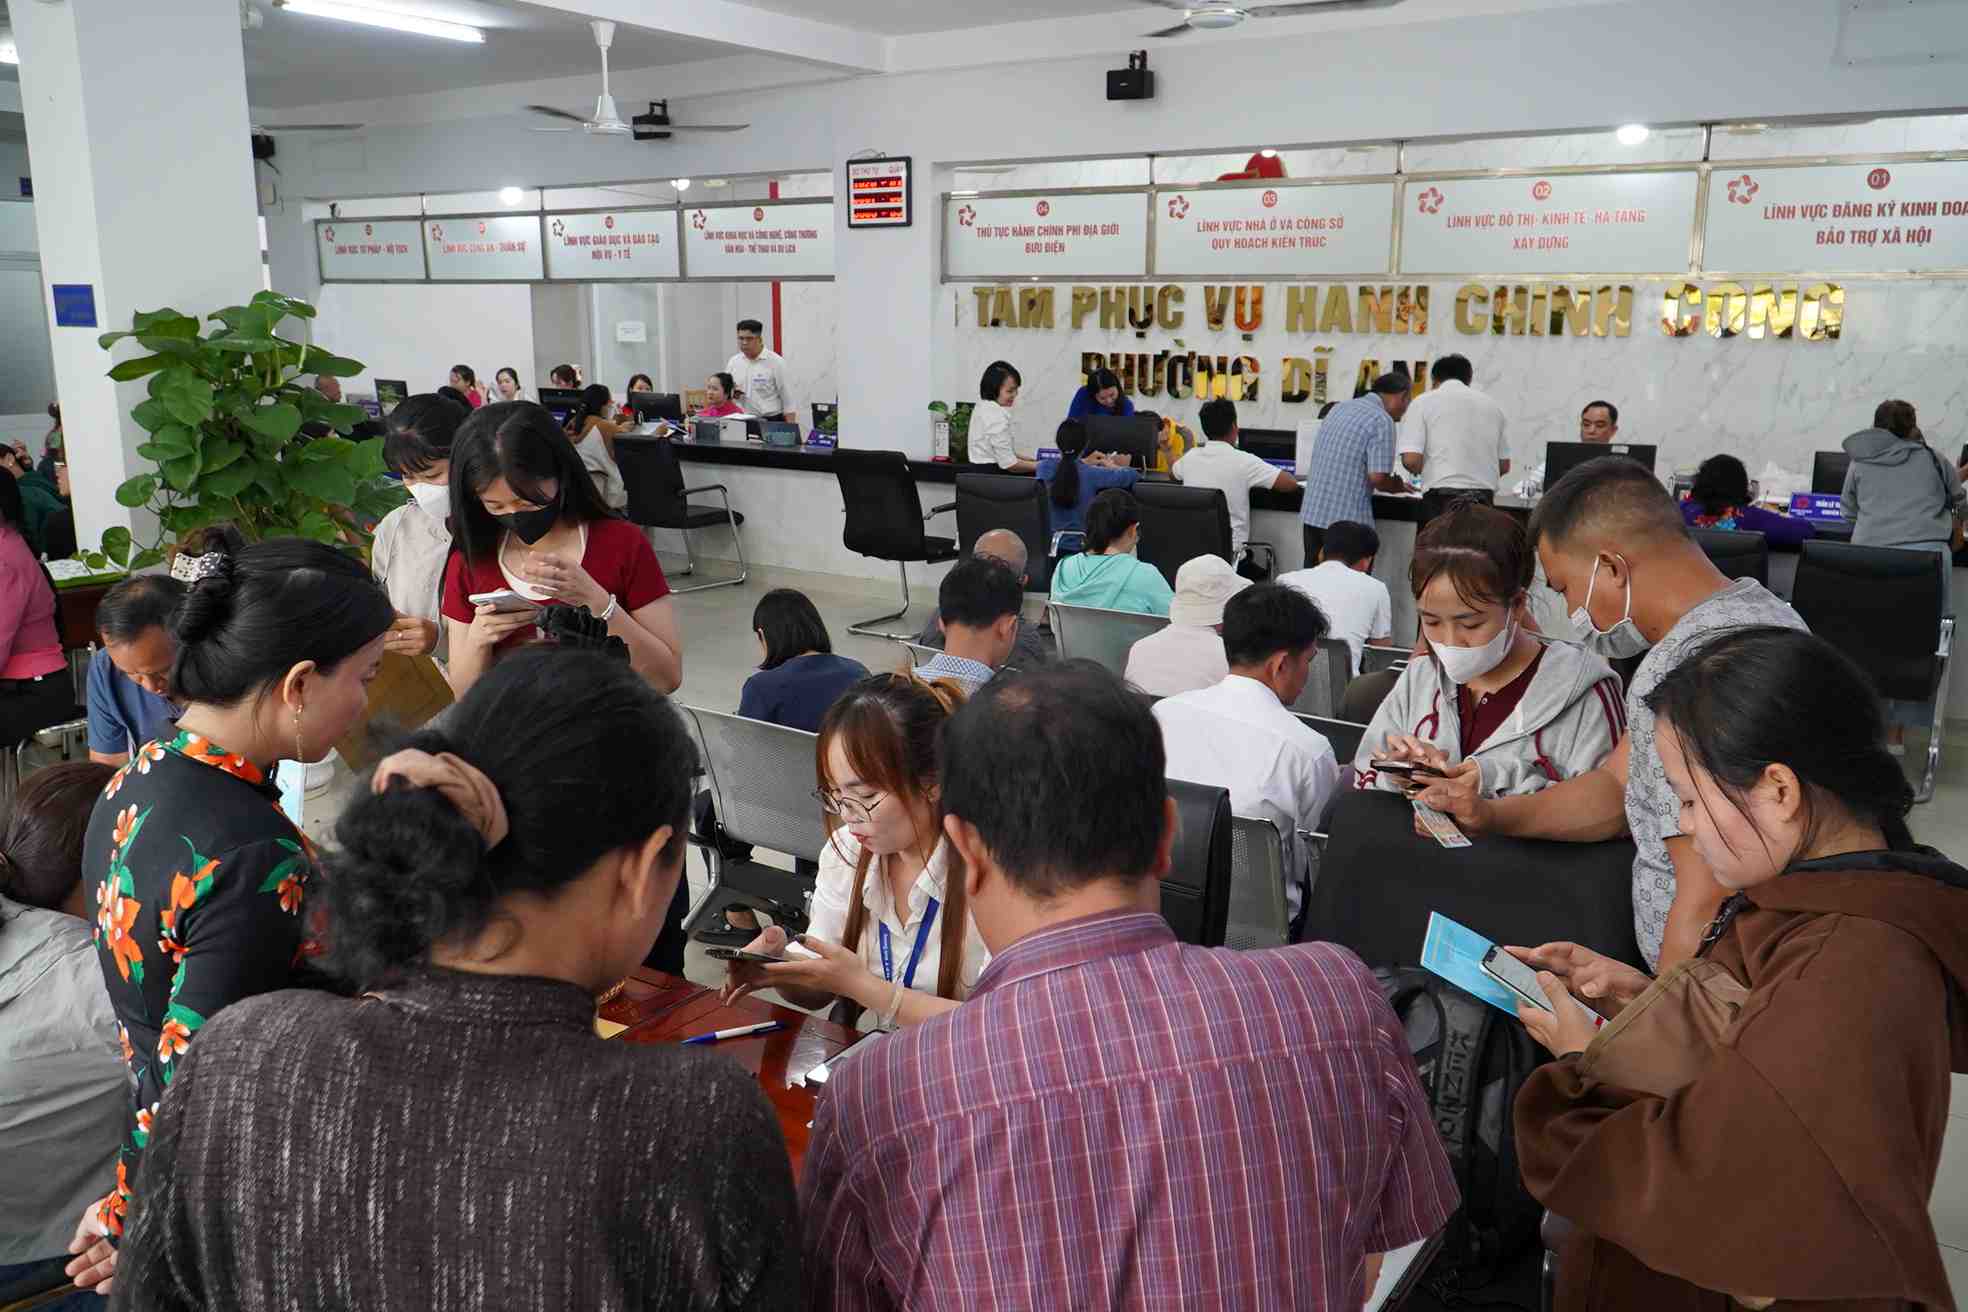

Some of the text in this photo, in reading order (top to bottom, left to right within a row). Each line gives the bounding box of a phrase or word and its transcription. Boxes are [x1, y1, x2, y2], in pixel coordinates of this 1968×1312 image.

[1542, 211, 1569, 224] KINH
[1900, 201, 1937, 217] KINH
[1906, 226, 1932, 247] HỘI
[1071, 284, 1185, 339] PHỤC
[1203, 286, 1265, 341] VỤ
